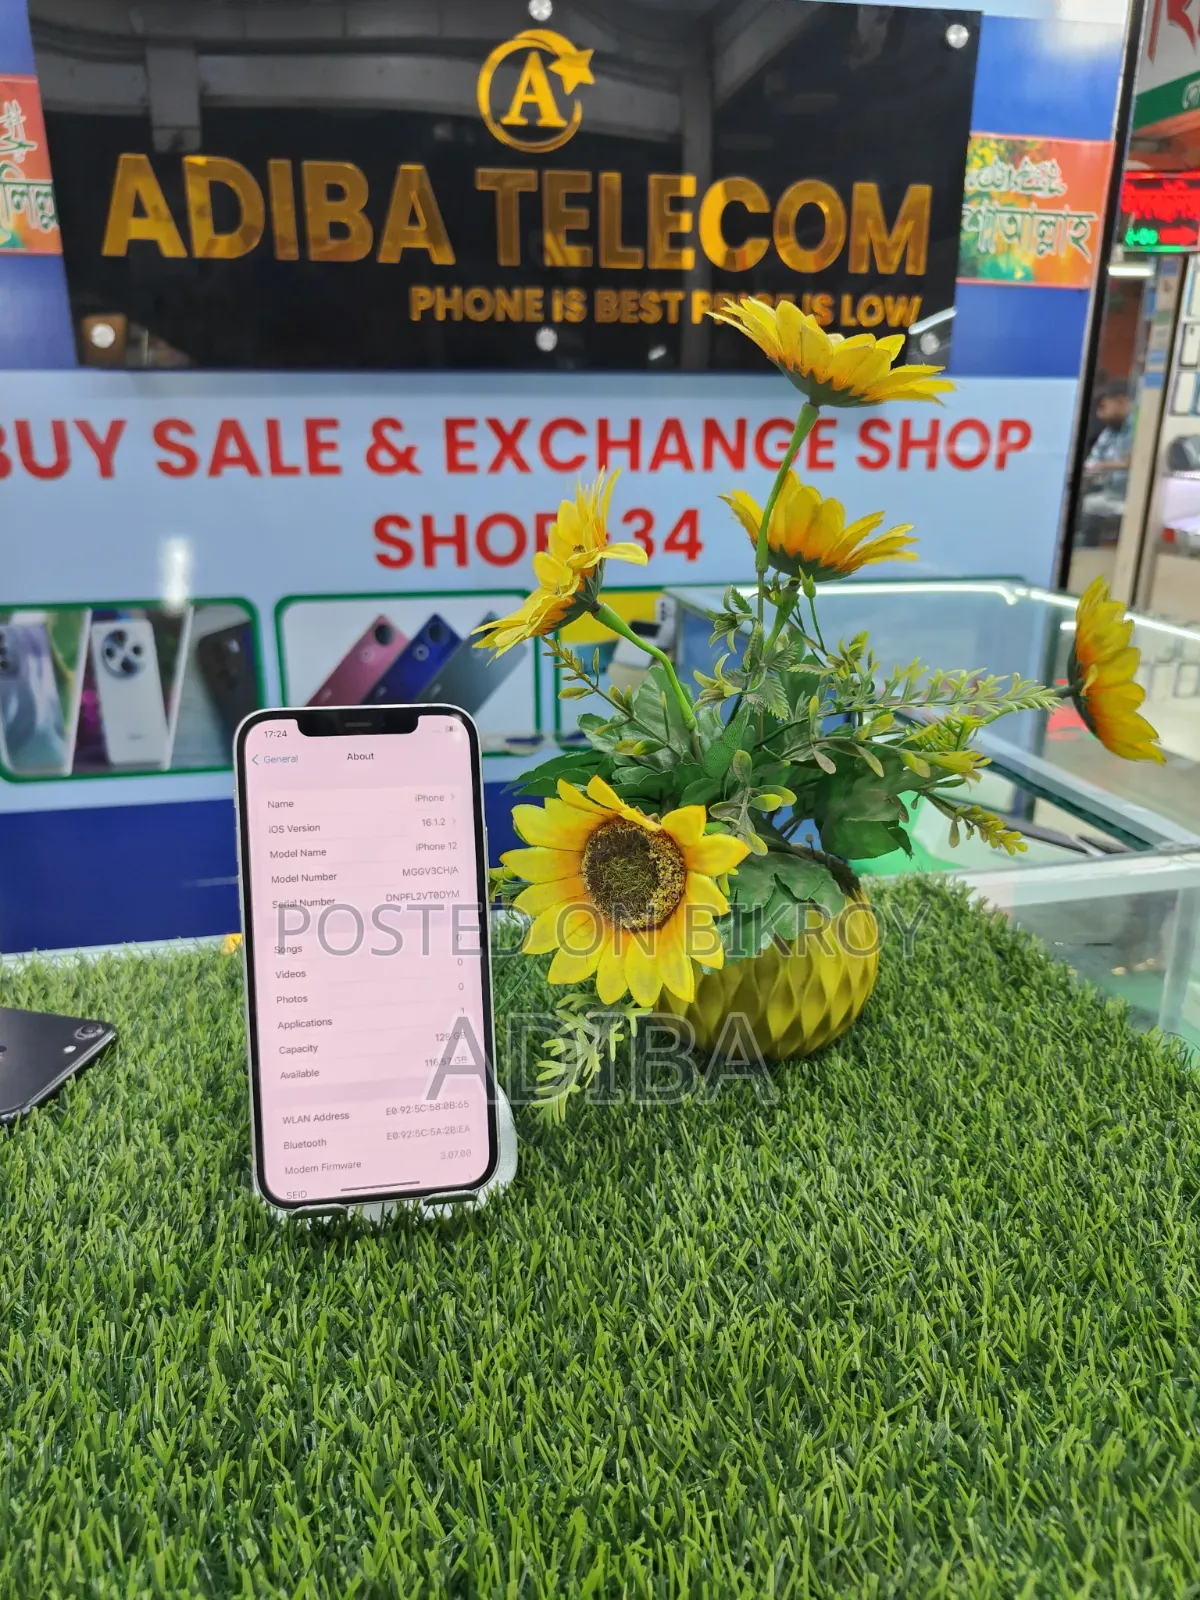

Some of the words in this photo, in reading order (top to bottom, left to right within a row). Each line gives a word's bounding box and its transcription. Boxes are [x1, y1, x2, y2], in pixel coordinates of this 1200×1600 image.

[102, 152, 457, 266] ADIBA
[475, 167, 933, 276] TELECOM
[409, 286, 545, 322] PHONE
[551, 287, 588, 323] IS
[594, 288, 686, 324] BEST
[840, 294, 923, 328] LOW
[152, 417, 343, 478] SALE
[365, 417, 422, 475] &
[444, 416, 837, 475] EXCHANGE
[856, 417, 1033, 471] SHOP
[264, 730, 288, 738] 17:24
[264, 755, 298, 764] General
[347, 752, 374, 761] About
[415, 793, 445, 803] iPhone
[267, 799, 294, 809] Name
[422, 818, 446, 827] 16.1.2
[268, 824, 285, 834] iOS
[287, 823, 321, 833] Version
[415, 842, 446, 852] iPhone
[448, 842, 457, 850] 12
[270, 849, 298, 859] Model
[300, 848, 327, 857] Name
[271, 874, 299, 884] Model
[301, 873, 337, 882] Number
[272, 899, 297, 909] Serial
[300, 898, 336, 907] Number
[274, 945, 303, 955] Songs
[457, 957, 463, 966] 0
[275, 970, 306, 979] Videos
[458, 982, 464, 991] 0
[276, 995, 308, 1004] Photos
[277, 1018, 333, 1030] Applications
[435, 1032, 451, 1042] 128
[279, 1044, 319, 1055] Capacity
[454, 1055, 467, 1065] GB
[280, 1068, 320, 1079] Available
[282, 1114, 311, 1125] WLAN
[313, 1111, 350, 1123] Address
[283, 1138, 327, 1150] Bluetooth
[284, 1164, 319, 1175] Modem
[321, 1160, 362, 1172] Firmware
[286, 1190, 308, 1200] SEID
